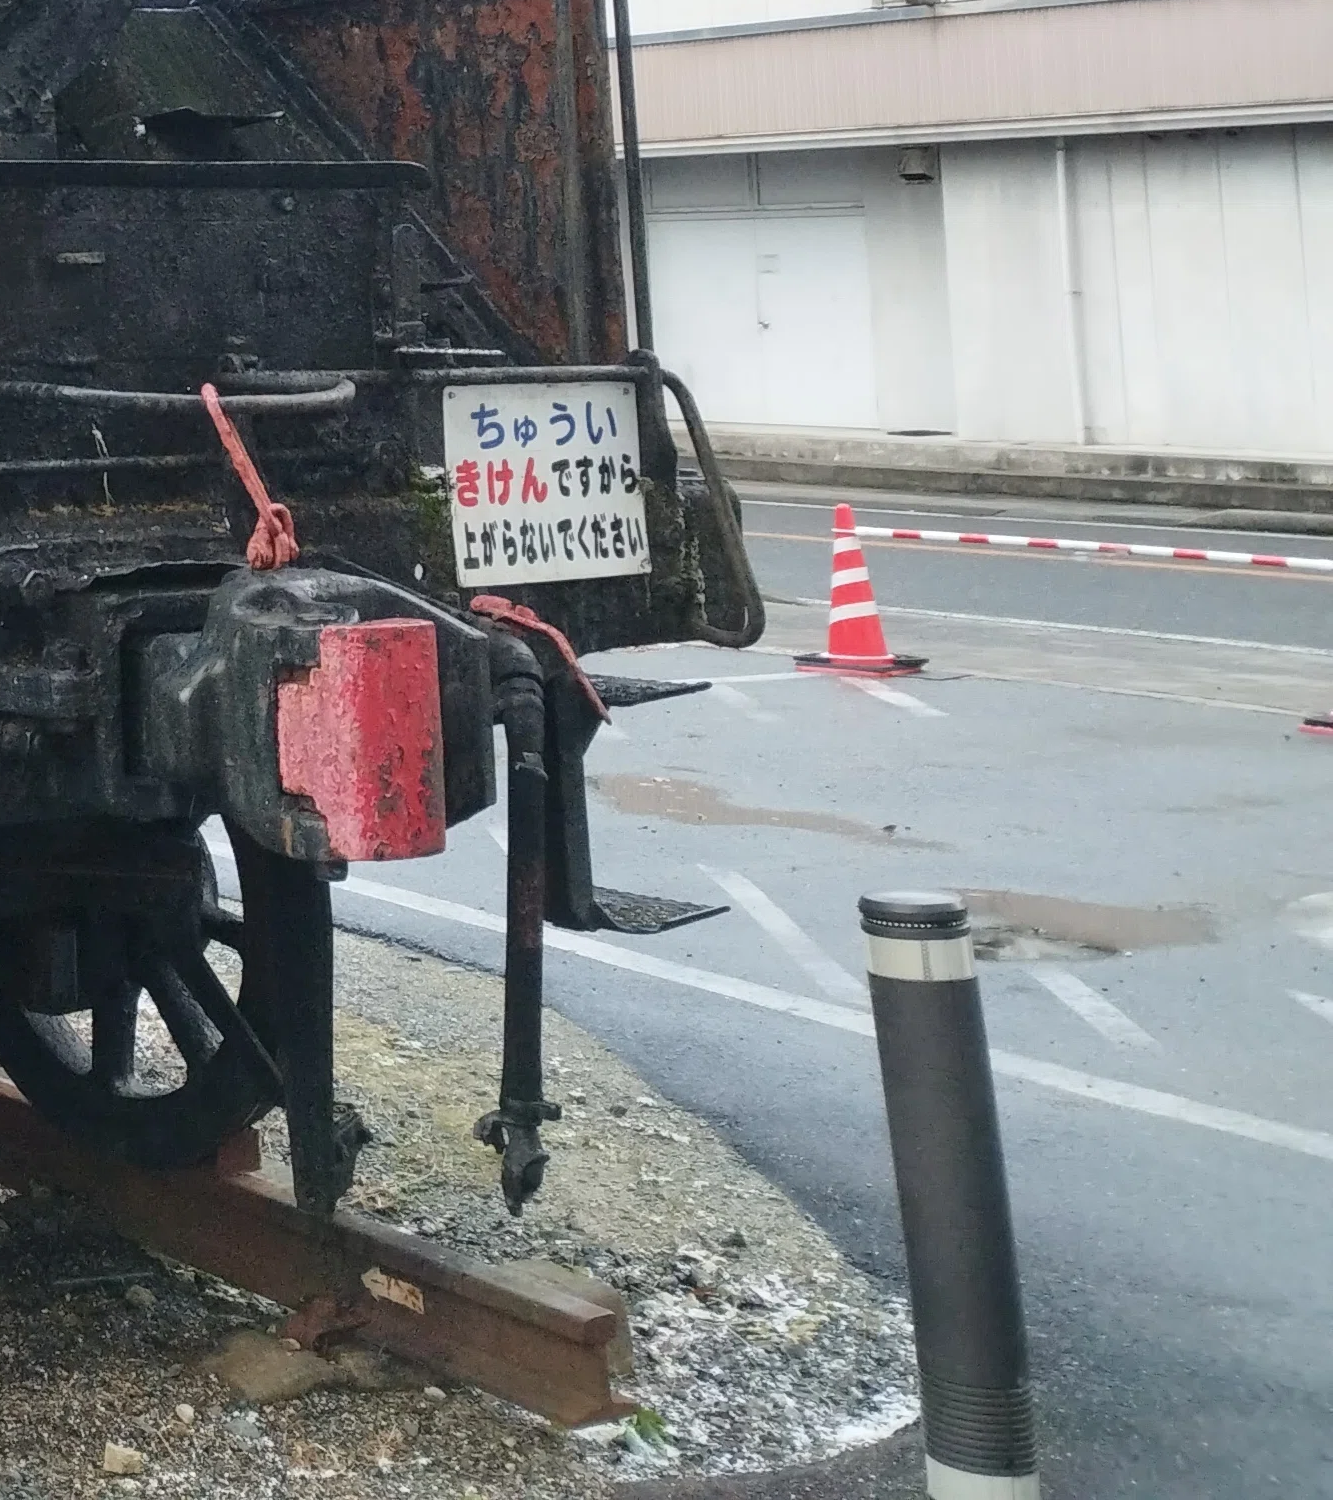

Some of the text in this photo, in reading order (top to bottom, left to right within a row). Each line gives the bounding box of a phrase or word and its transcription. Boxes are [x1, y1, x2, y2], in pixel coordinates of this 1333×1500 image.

[470, 401, 617, 449] ちゅうい
[456, 454, 636, 507] きけんですから
[463, 513, 644, 570] 上がらないでください
